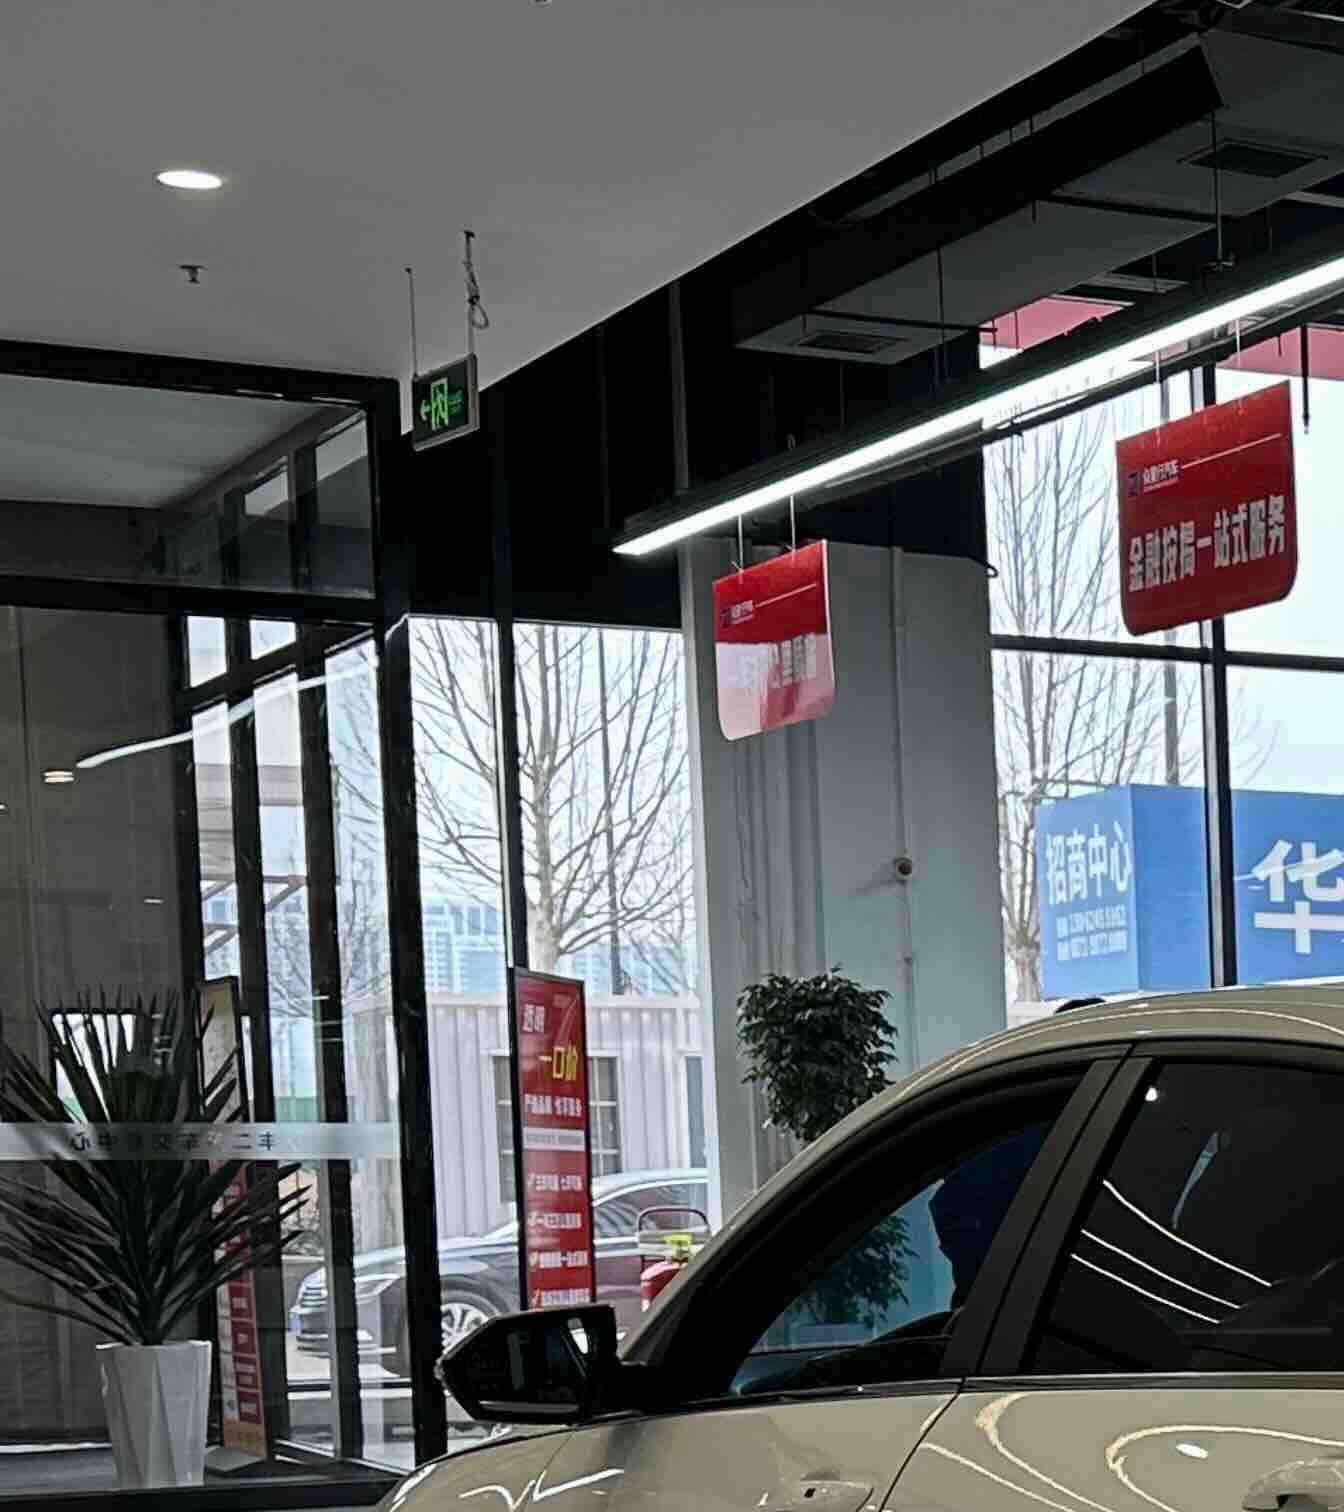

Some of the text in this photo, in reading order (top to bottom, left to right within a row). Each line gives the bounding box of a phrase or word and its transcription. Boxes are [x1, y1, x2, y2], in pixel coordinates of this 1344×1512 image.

[1129, 495, 1285, 592] 金融按揭一站式服务
[1045, 821, 1133, 906] 招商中心
